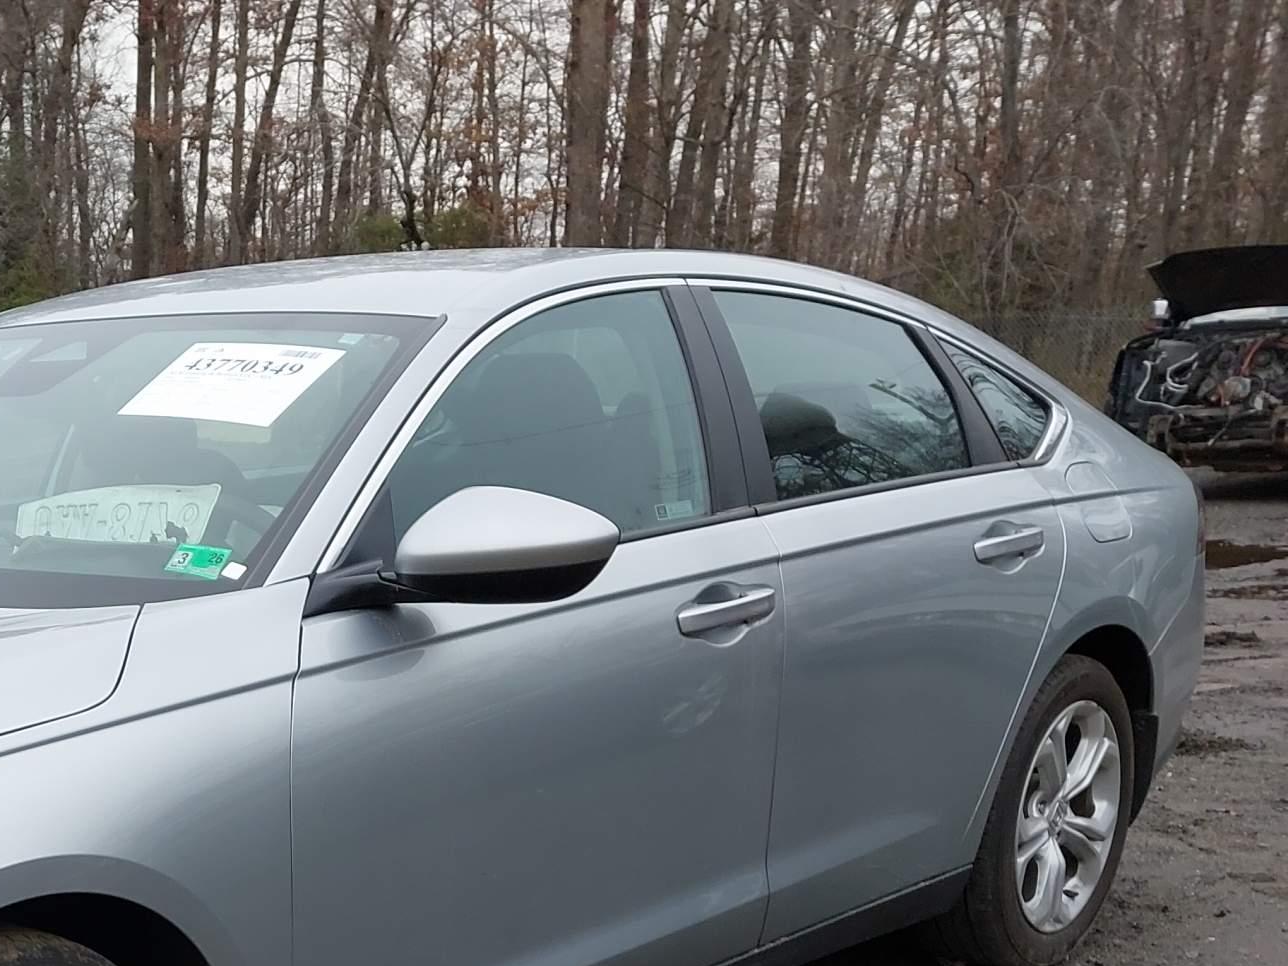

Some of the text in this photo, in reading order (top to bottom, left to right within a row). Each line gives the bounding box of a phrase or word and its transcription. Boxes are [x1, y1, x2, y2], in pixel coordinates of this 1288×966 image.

[184, 357, 304, 376] 43770349
[177, 552, 225, 565] 3 26
